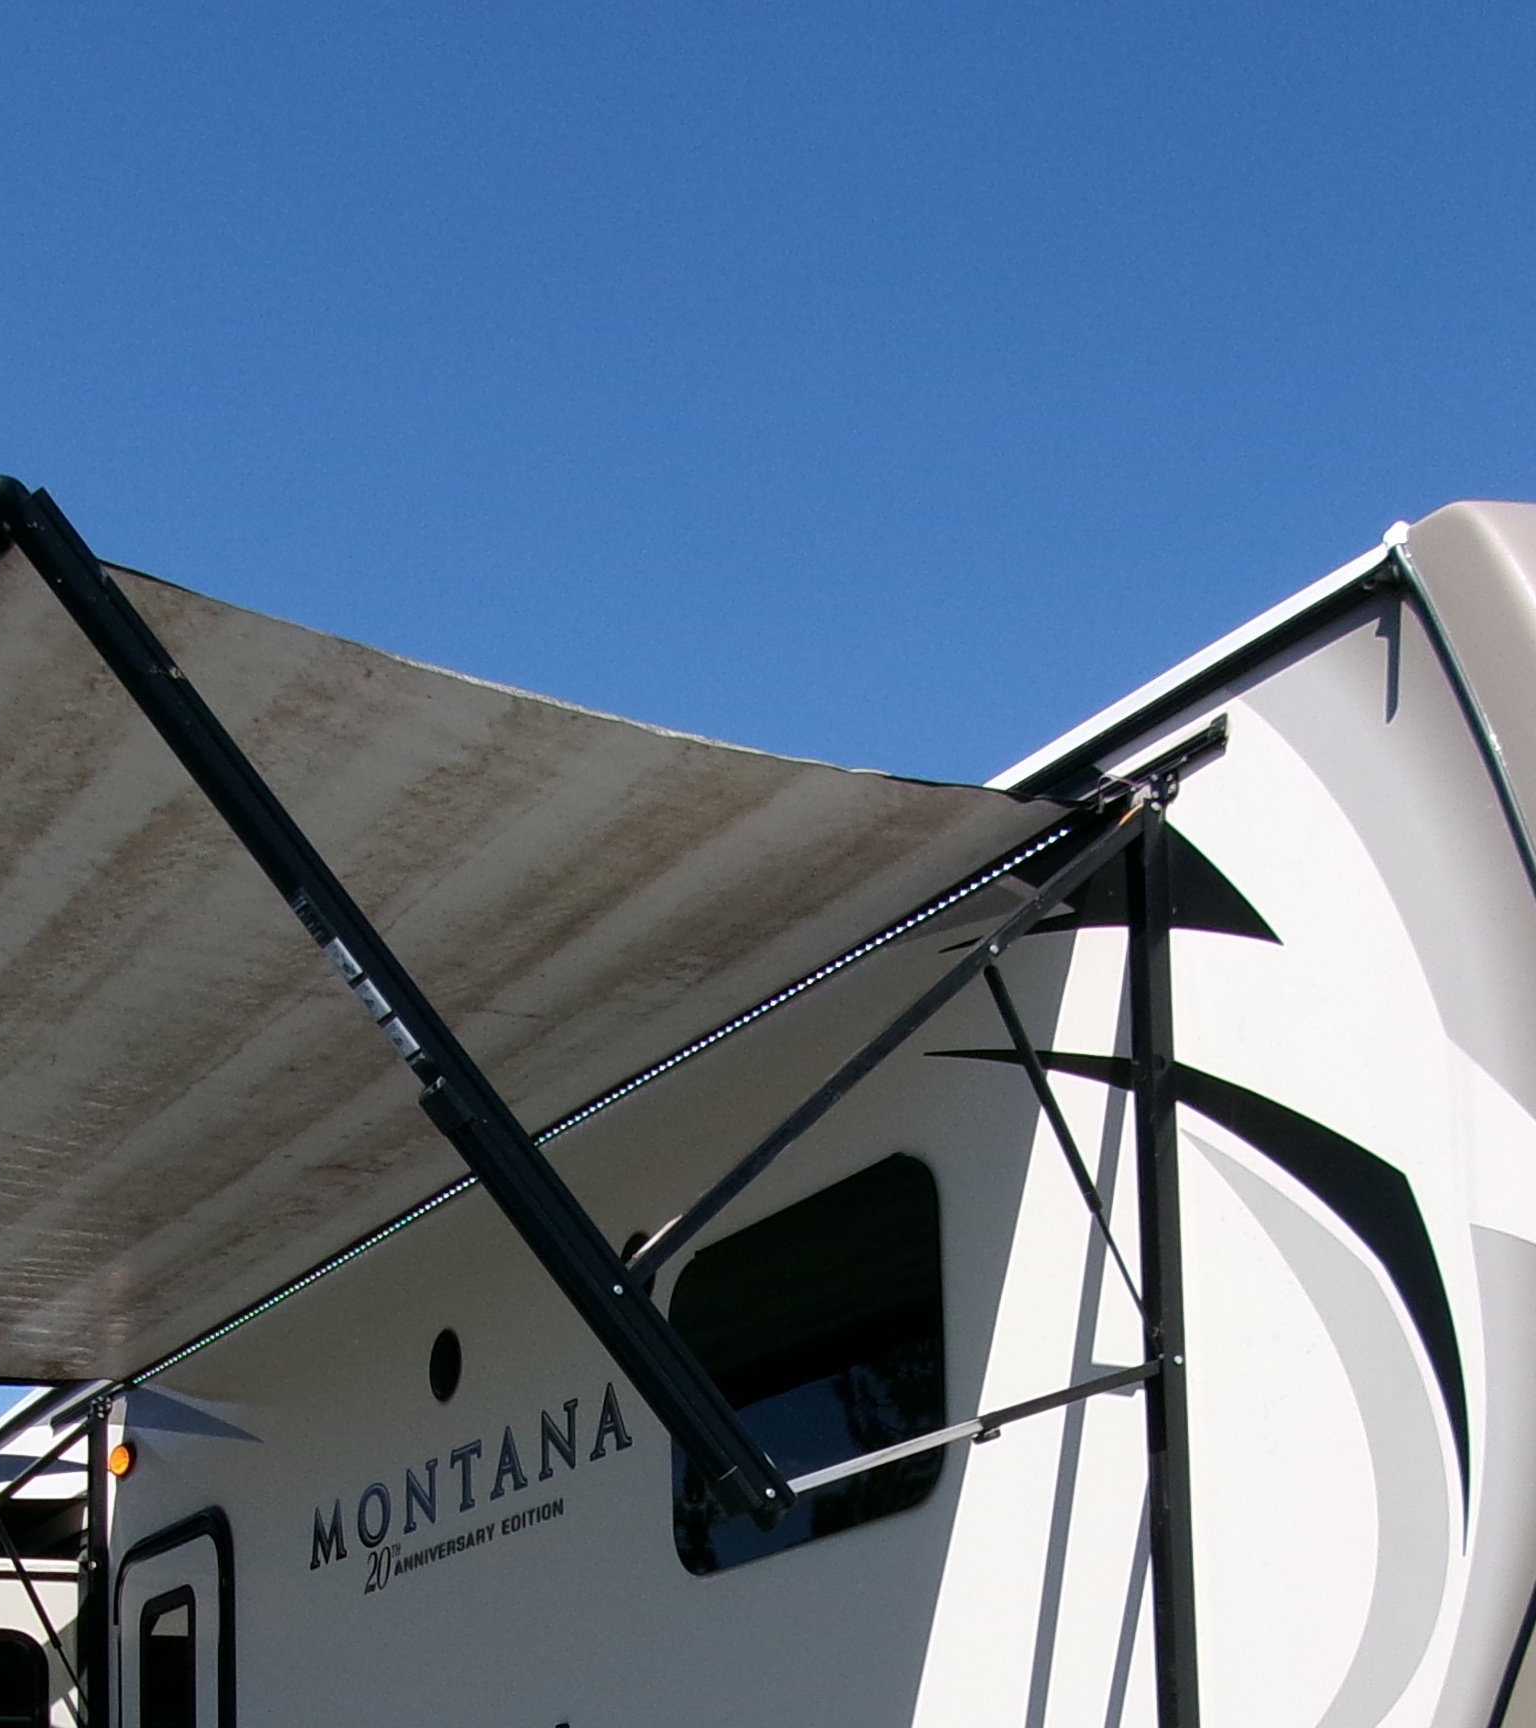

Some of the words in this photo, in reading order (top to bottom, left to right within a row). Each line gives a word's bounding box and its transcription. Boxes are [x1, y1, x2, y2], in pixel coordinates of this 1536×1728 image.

[310, 1381, 633, 1570] MONTANA
[394, 1522, 496, 1576] ANNIVERSARY
[502, 1498, 564, 1536] EDITION
